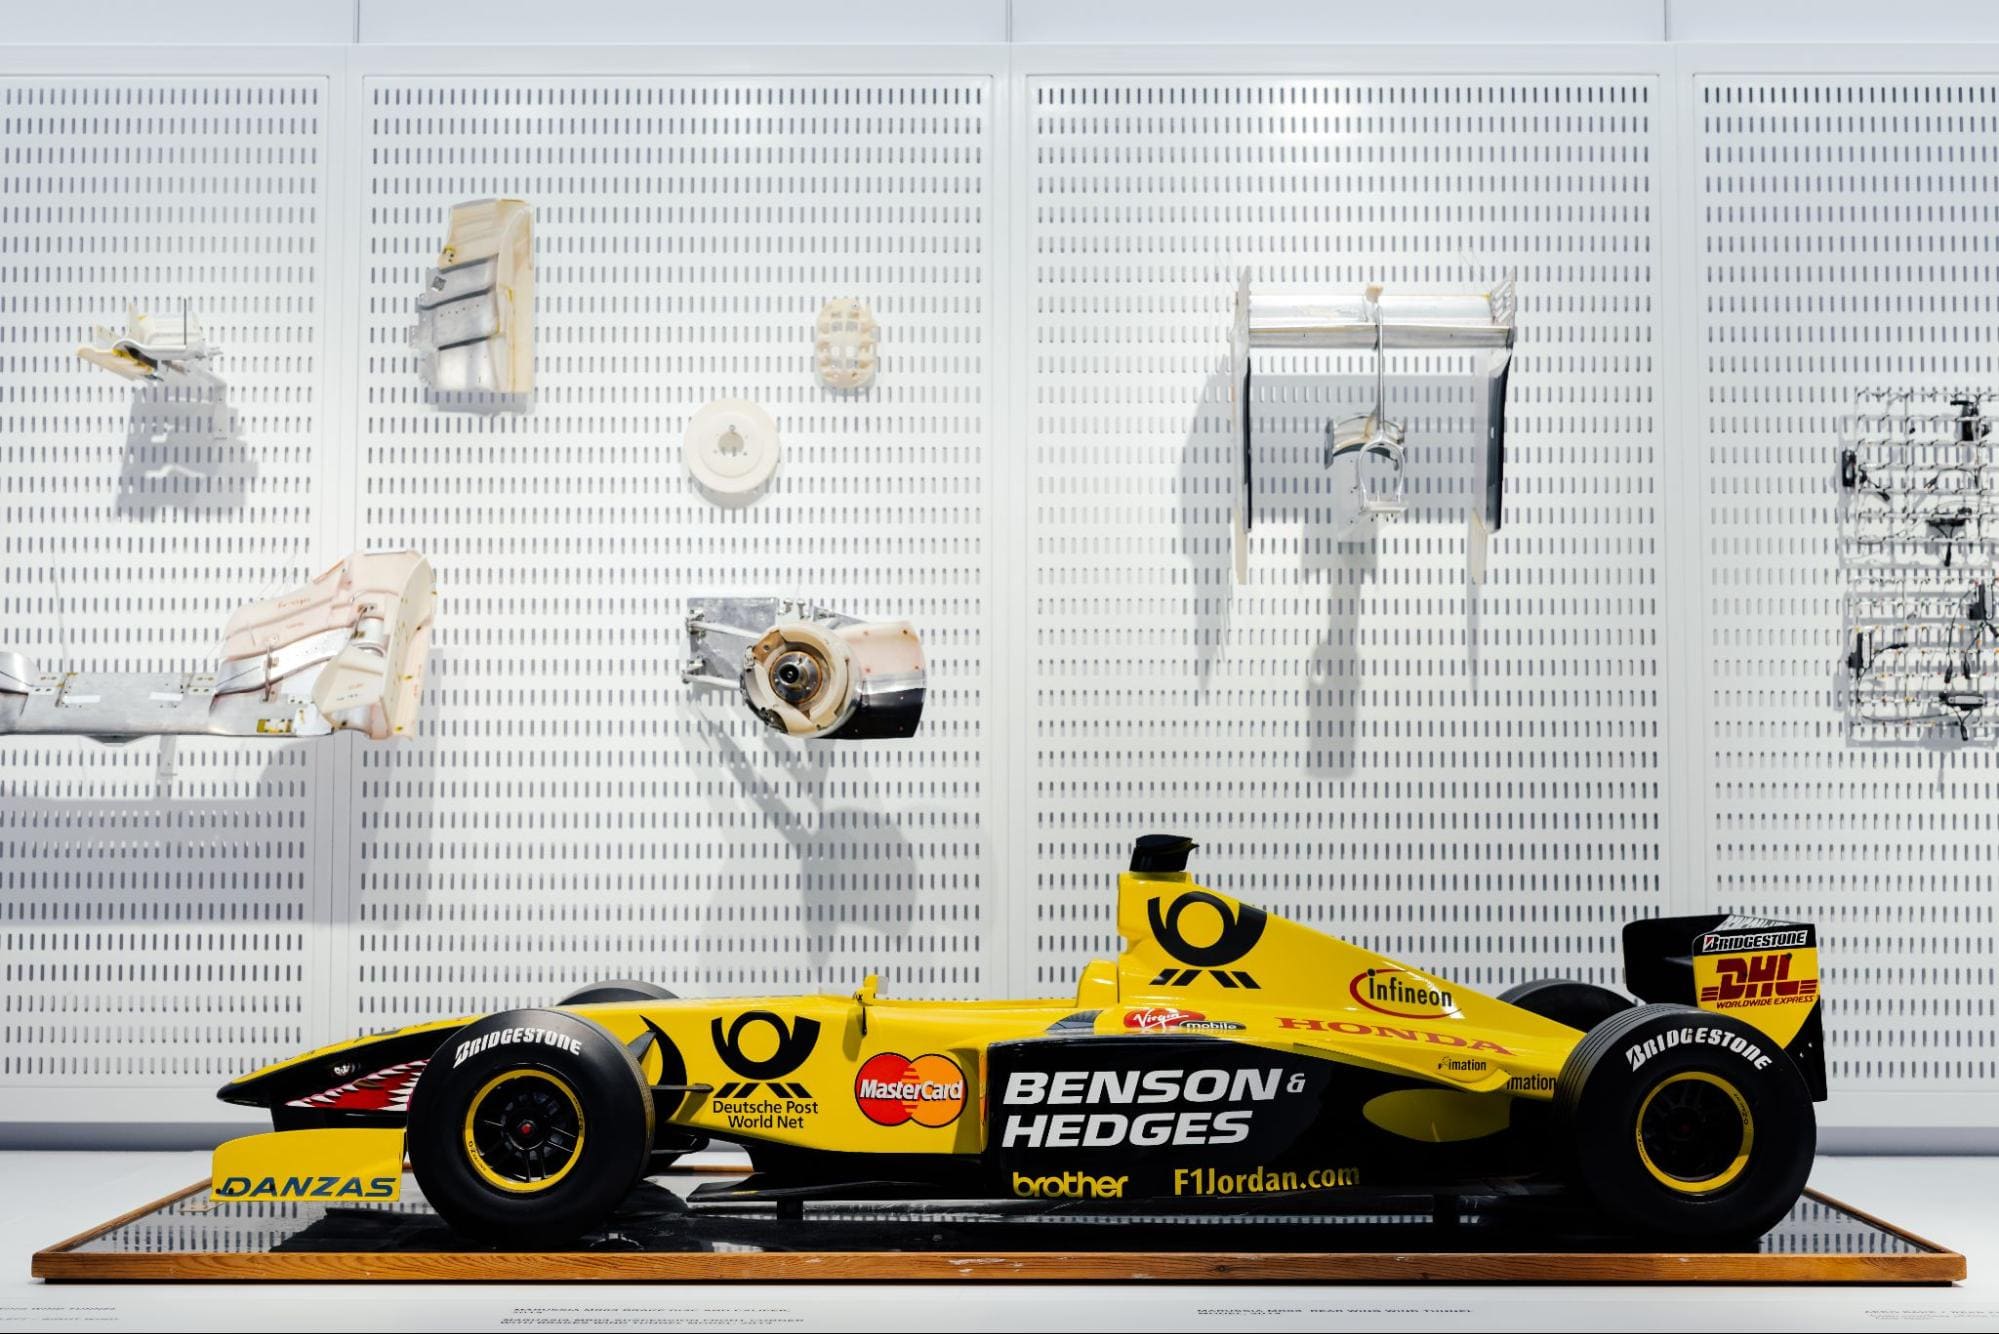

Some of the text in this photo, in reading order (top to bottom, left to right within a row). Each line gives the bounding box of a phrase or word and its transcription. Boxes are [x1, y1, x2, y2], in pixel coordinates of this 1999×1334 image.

[1702, 930, 1808, 953] BRIDGESTONE
[1716, 954, 1801, 1000] DHL
[1716, 995, 1814, 1009] WORLDWIDE EXPRESS
[1133, 1008, 1238, 1030] Virgin mobile
[453, 1027, 582, 1069] BRIDGESTONE
[1277, 1017, 1519, 1057] HONDA
[1625, 1028, 1774, 1073] BRIDGESTONE
[1449, 1059, 1487, 1071] imation
[859, 1079, 963, 1102] MasterCard
[1003, 1068, 1306, 1105] BENSON &
[713, 1100, 819, 1114] Deutsche Post
[728, 1115, 804, 1129] World Net
[1001, 1110, 1254, 1148] HEDGES
[220, 1176, 397, 1199] DANZAS
[1012, 1172, 1130, 1199] brother
[1174, 1166, 1361, 1196] F1Jordan.com
